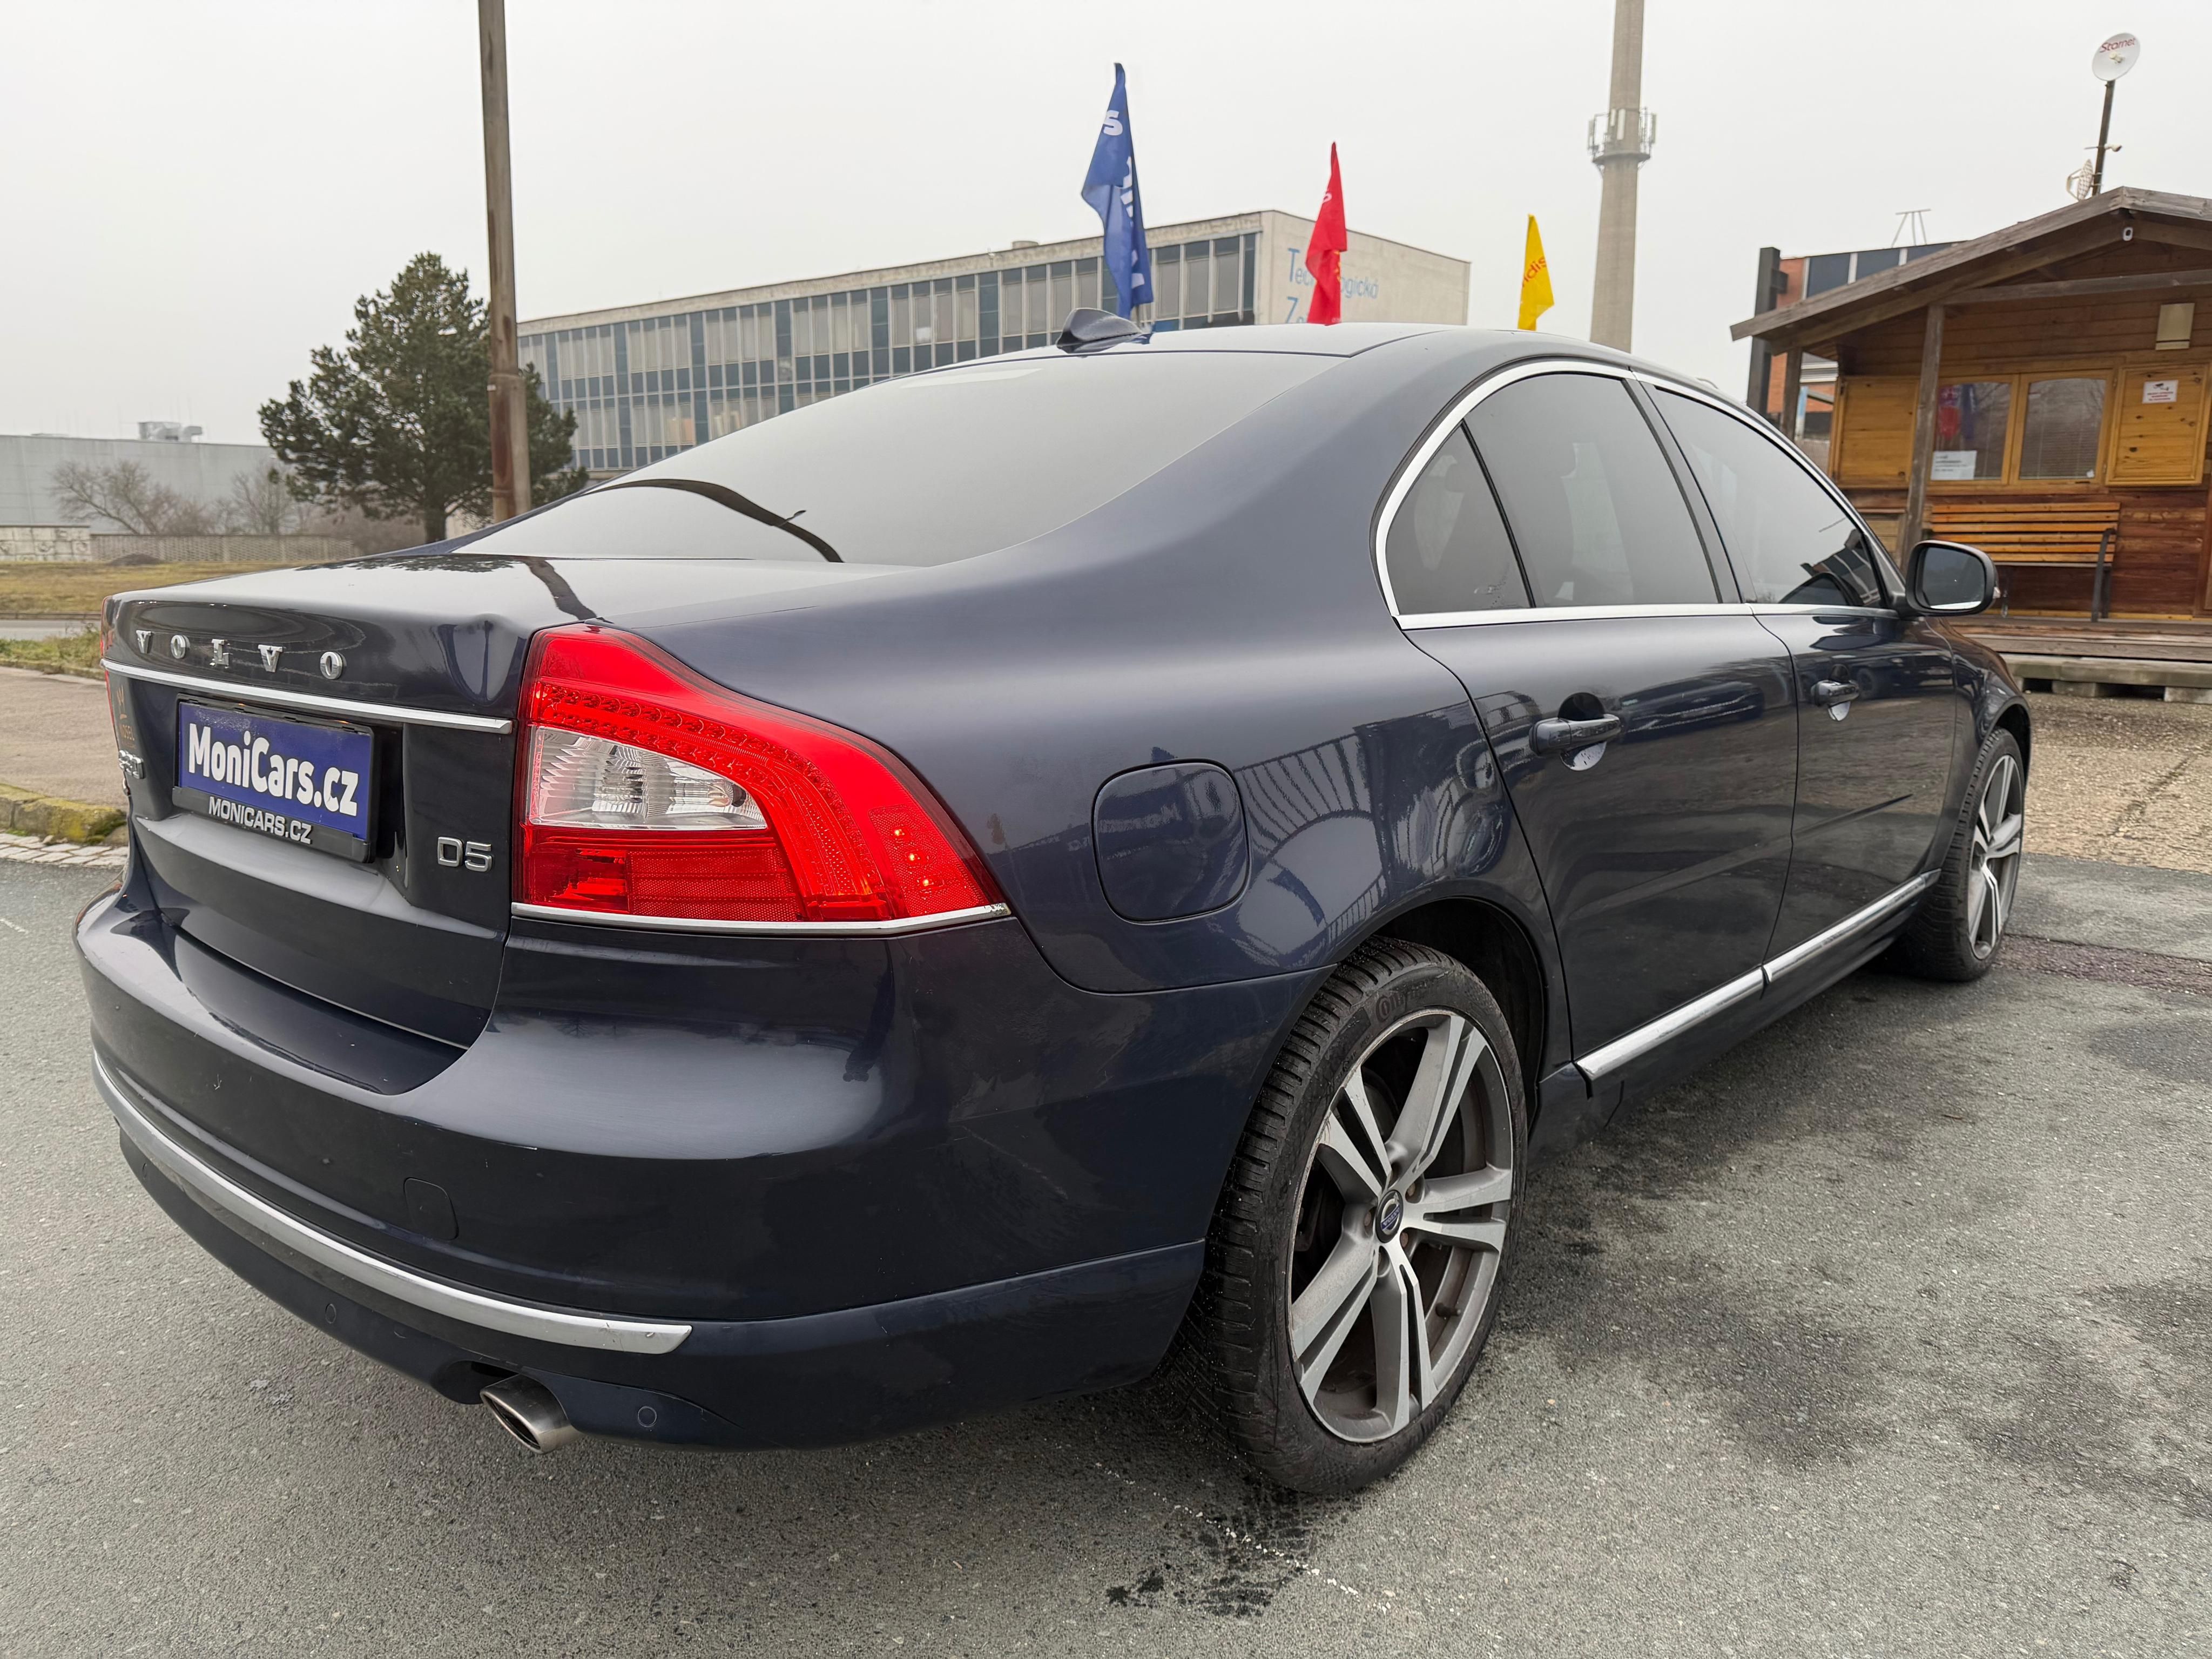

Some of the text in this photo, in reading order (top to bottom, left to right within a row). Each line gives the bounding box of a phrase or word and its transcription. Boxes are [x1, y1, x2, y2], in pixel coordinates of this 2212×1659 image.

[136, 629, 347, 680] VOLVO
[188, 723, 360, 817] MoniCars.cz
[208, 796, 312, 845] MONICARS.CZ
[437, 836, 493, 872] D5
